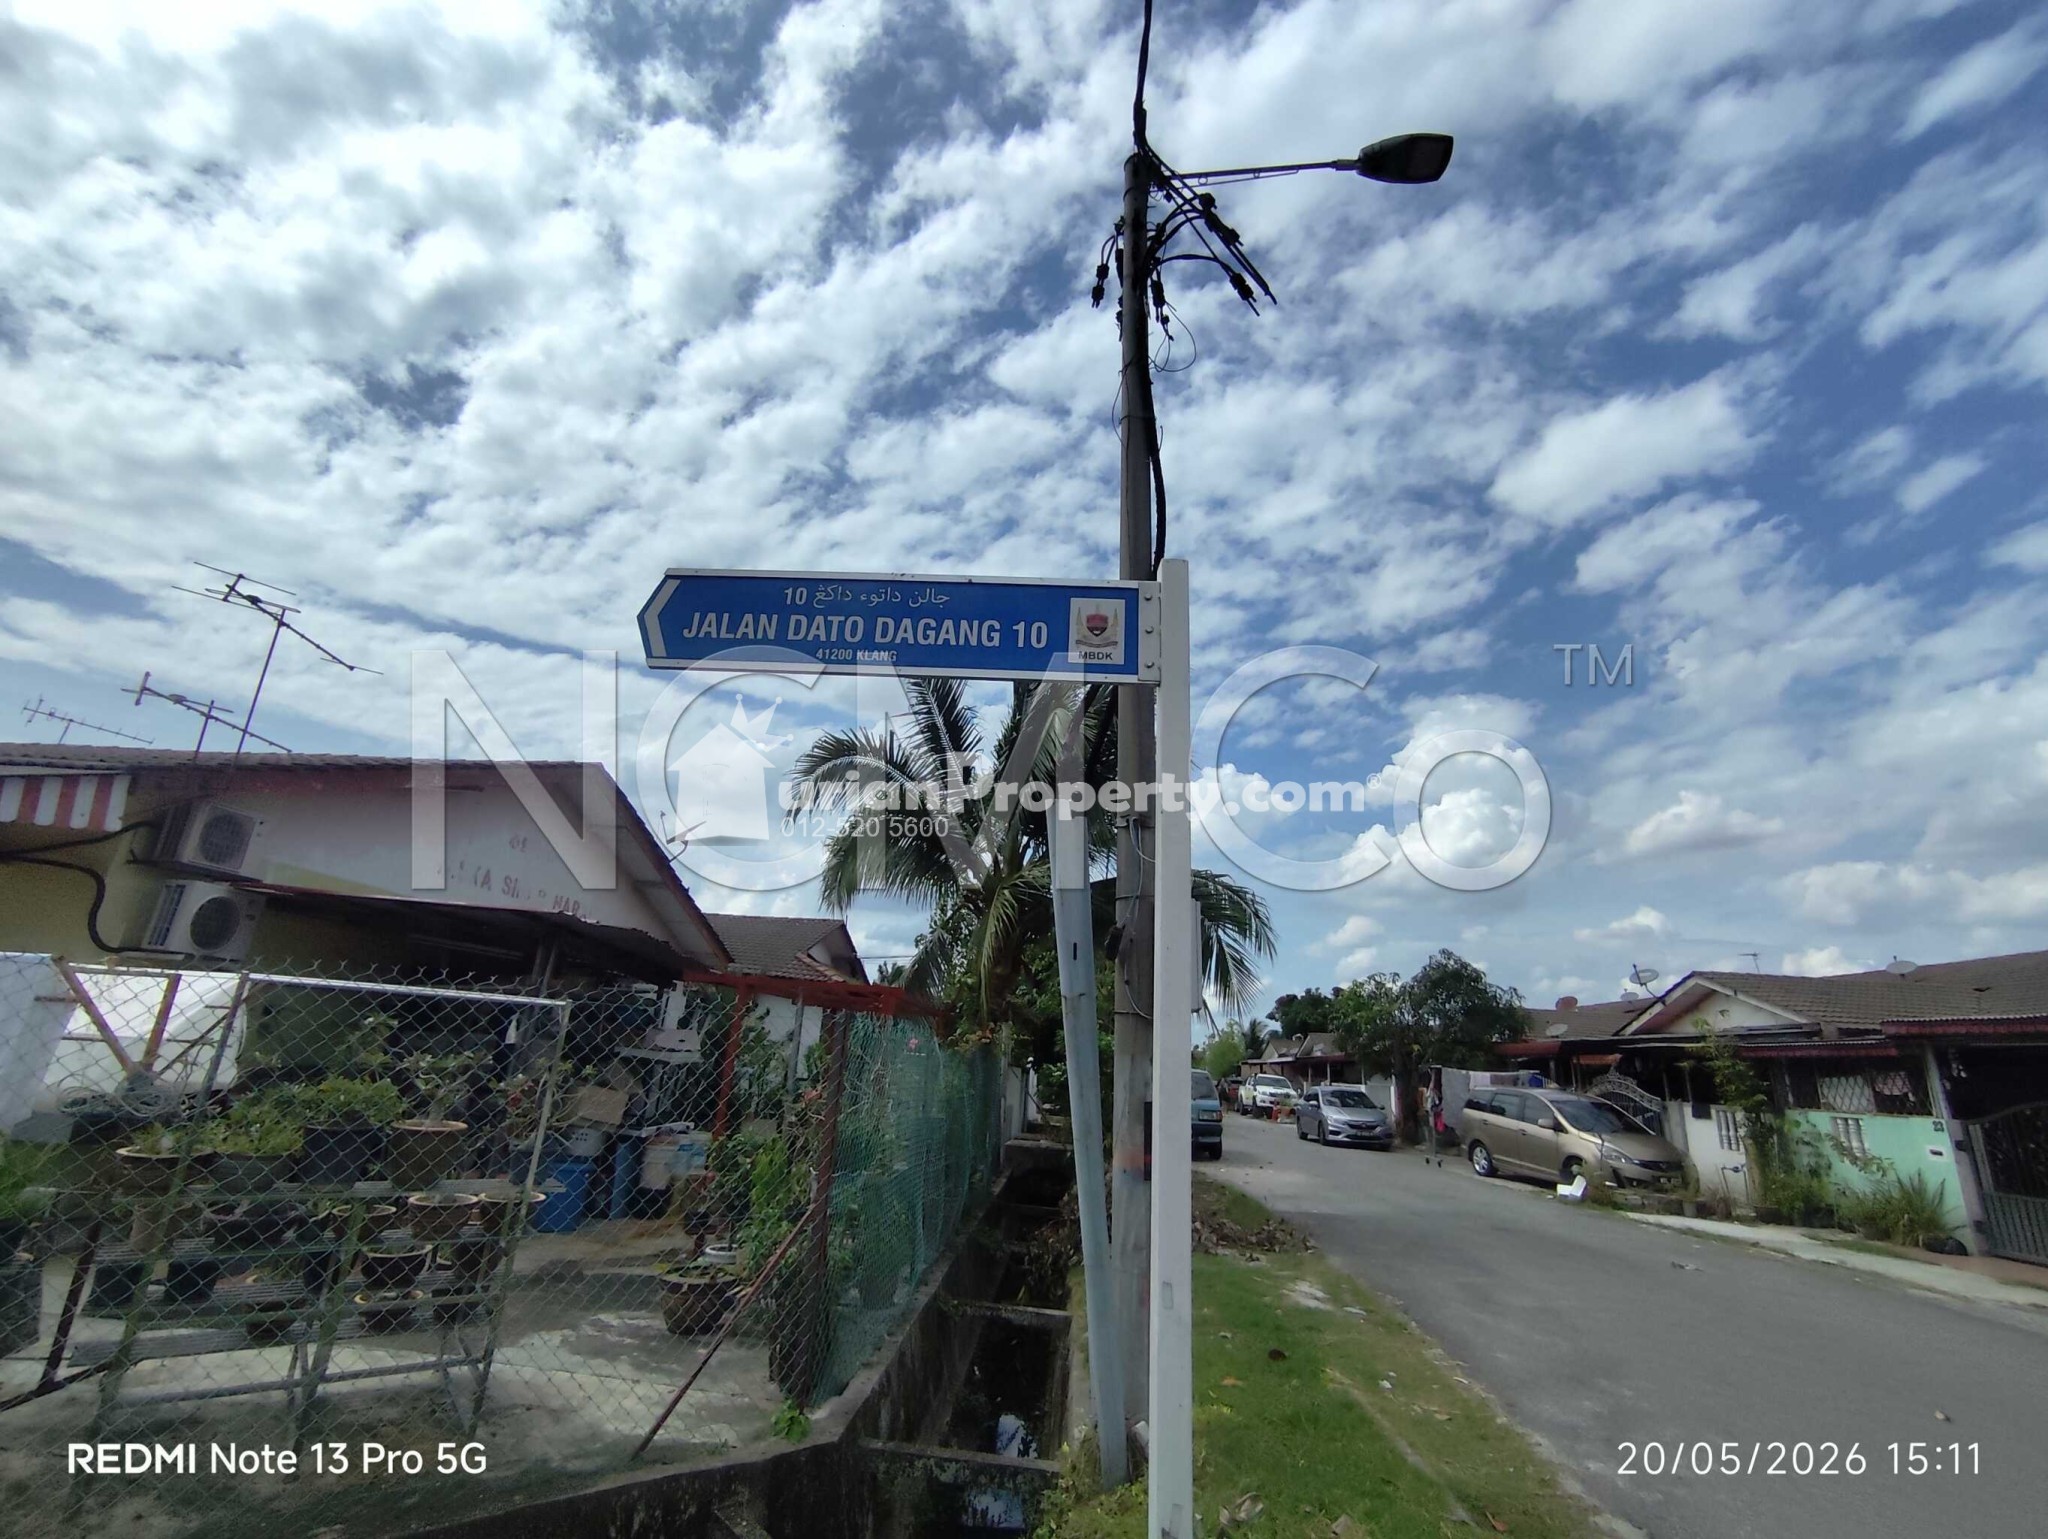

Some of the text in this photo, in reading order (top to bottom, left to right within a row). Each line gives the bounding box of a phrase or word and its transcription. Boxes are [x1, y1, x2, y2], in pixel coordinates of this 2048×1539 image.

[784, 587, 808, 606] 10
[909, 587, 950, 608] جالن
[683, 612, 1048, 649] JALAN DATO DAGANG 10
[816, 648, 897, 662] 41200 KLANG
[1079, 651, 1113, 661] MBDK
